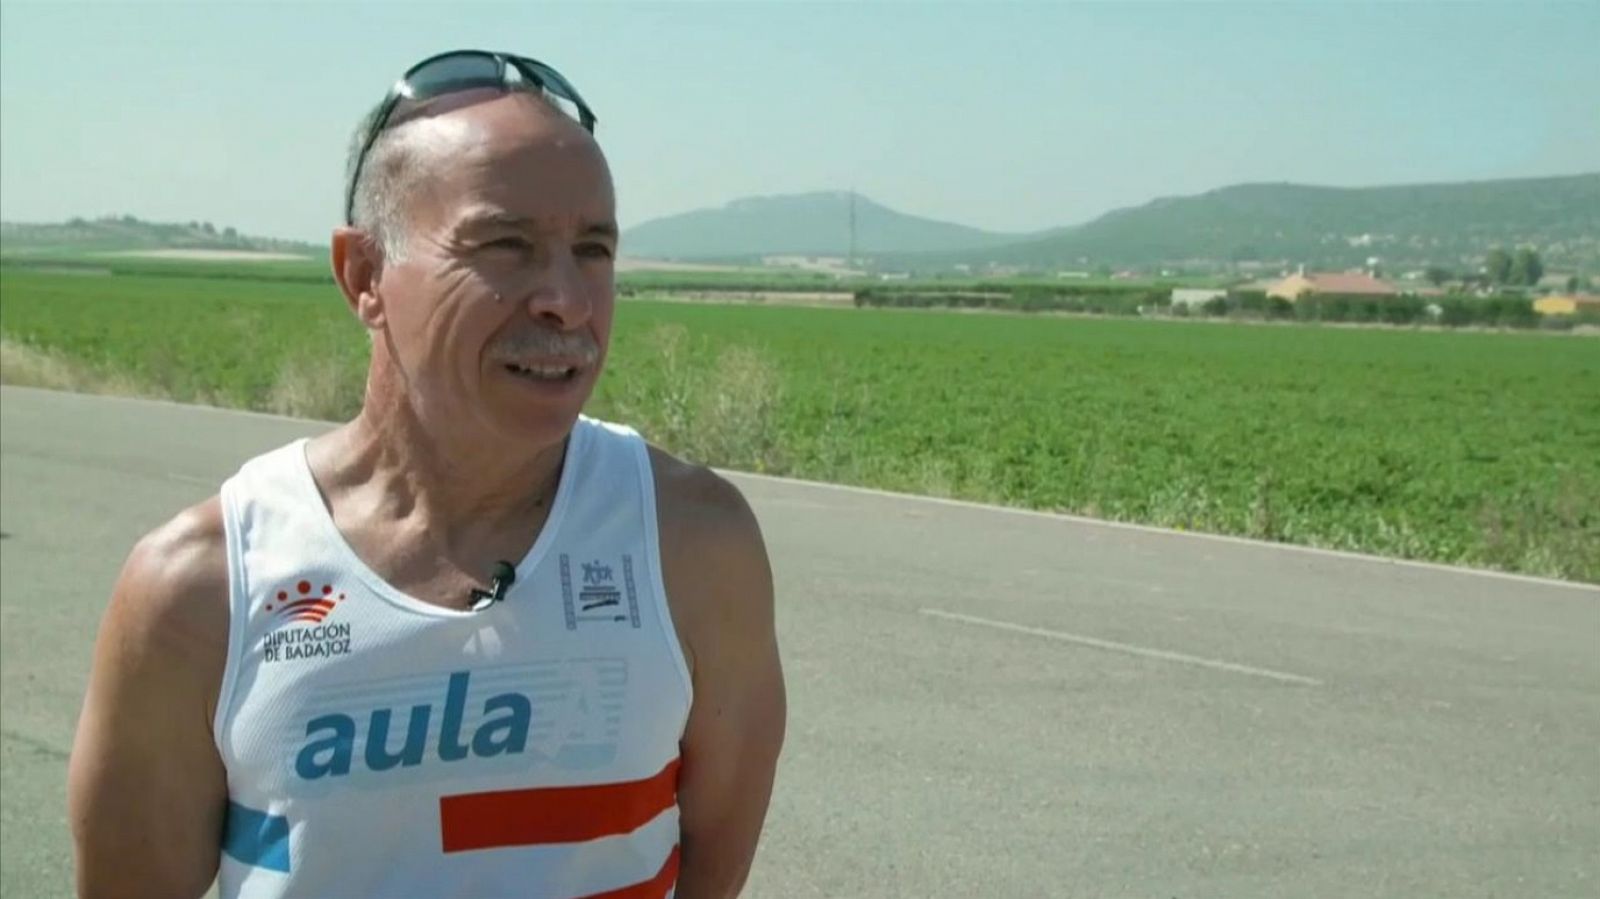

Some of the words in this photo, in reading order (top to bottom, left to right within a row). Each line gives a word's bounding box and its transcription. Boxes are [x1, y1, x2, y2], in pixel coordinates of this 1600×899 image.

[263, 622, 351, 649] DIPUTACIÓN
[264, 647, 280, 662] DE
[285, 639, 351, 660] BADAJOZ
[295, 671, 532, 780] aula
